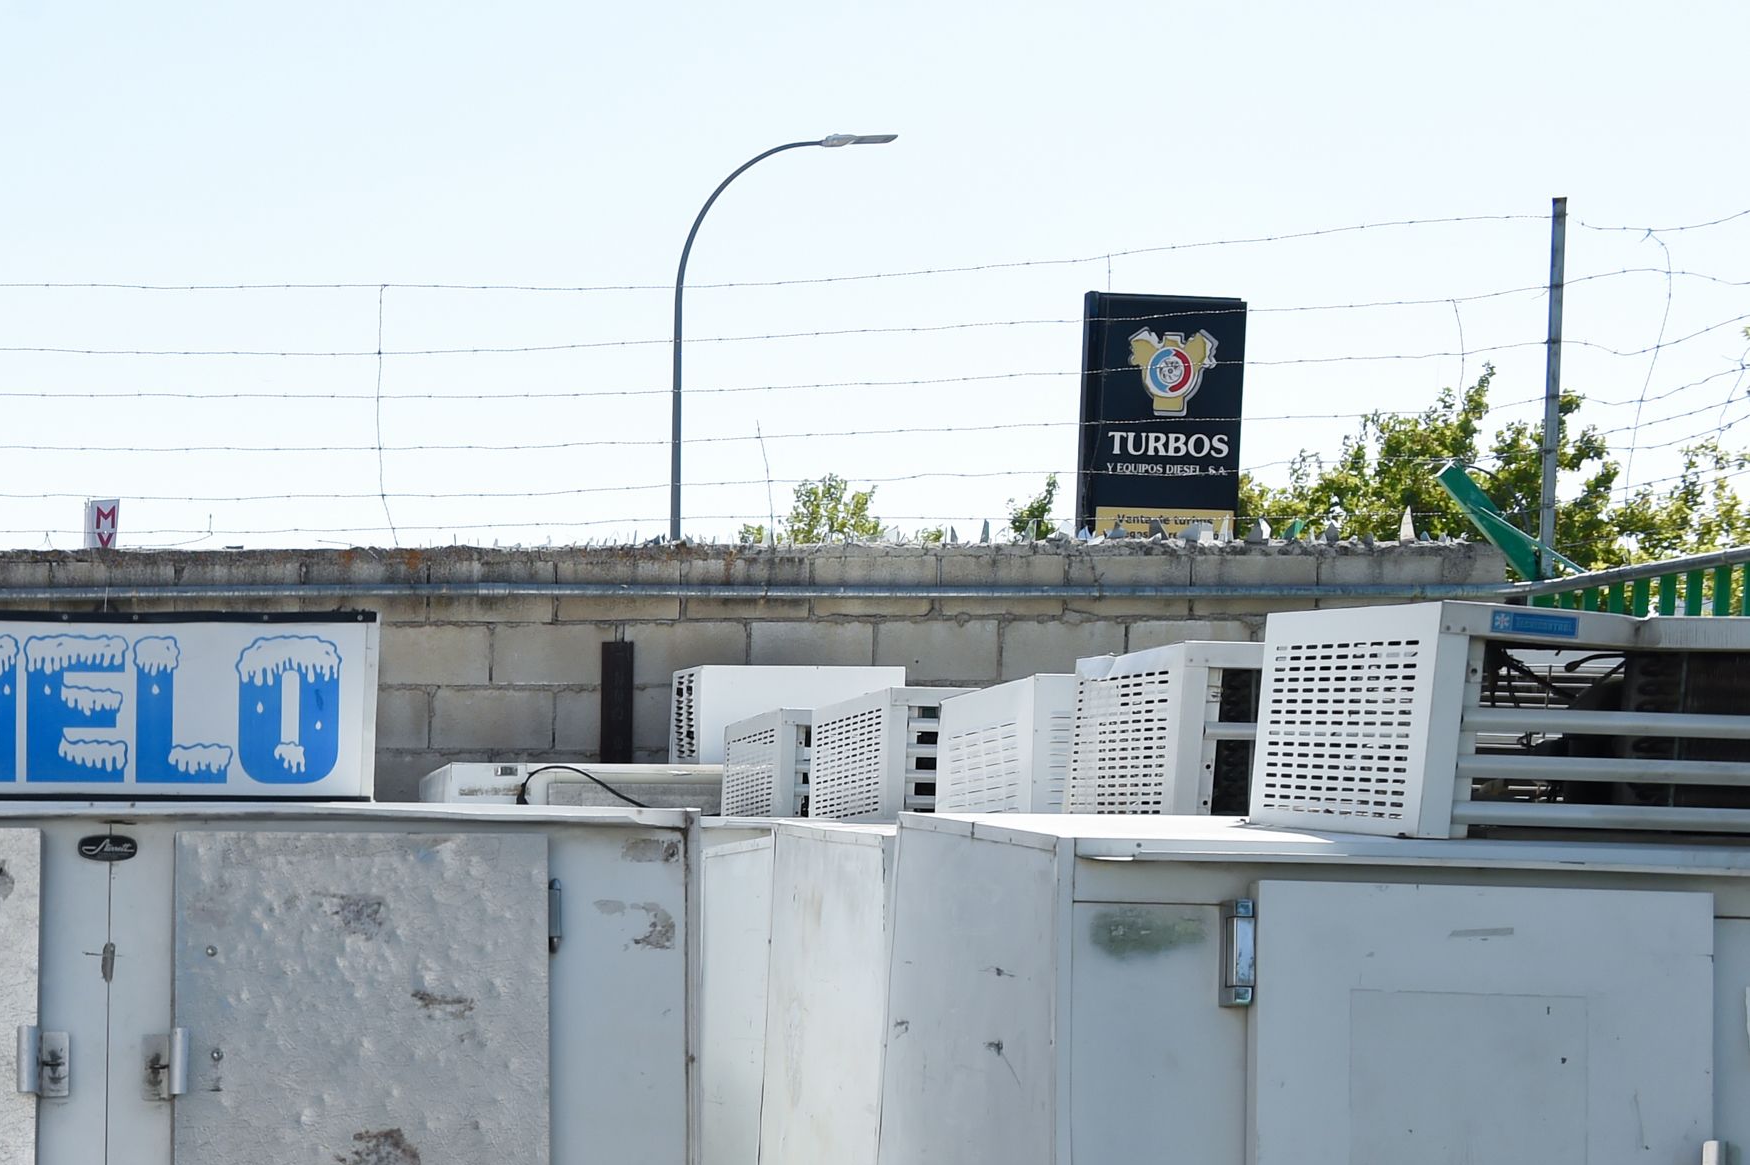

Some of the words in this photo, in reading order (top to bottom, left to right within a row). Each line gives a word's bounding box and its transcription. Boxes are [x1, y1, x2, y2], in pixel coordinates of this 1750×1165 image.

[1107, 431, 1229, 458] TURBOS
[1106, 462, 1114, 473] Y
[1116, 463, 1163, 474] EQUIPOS
